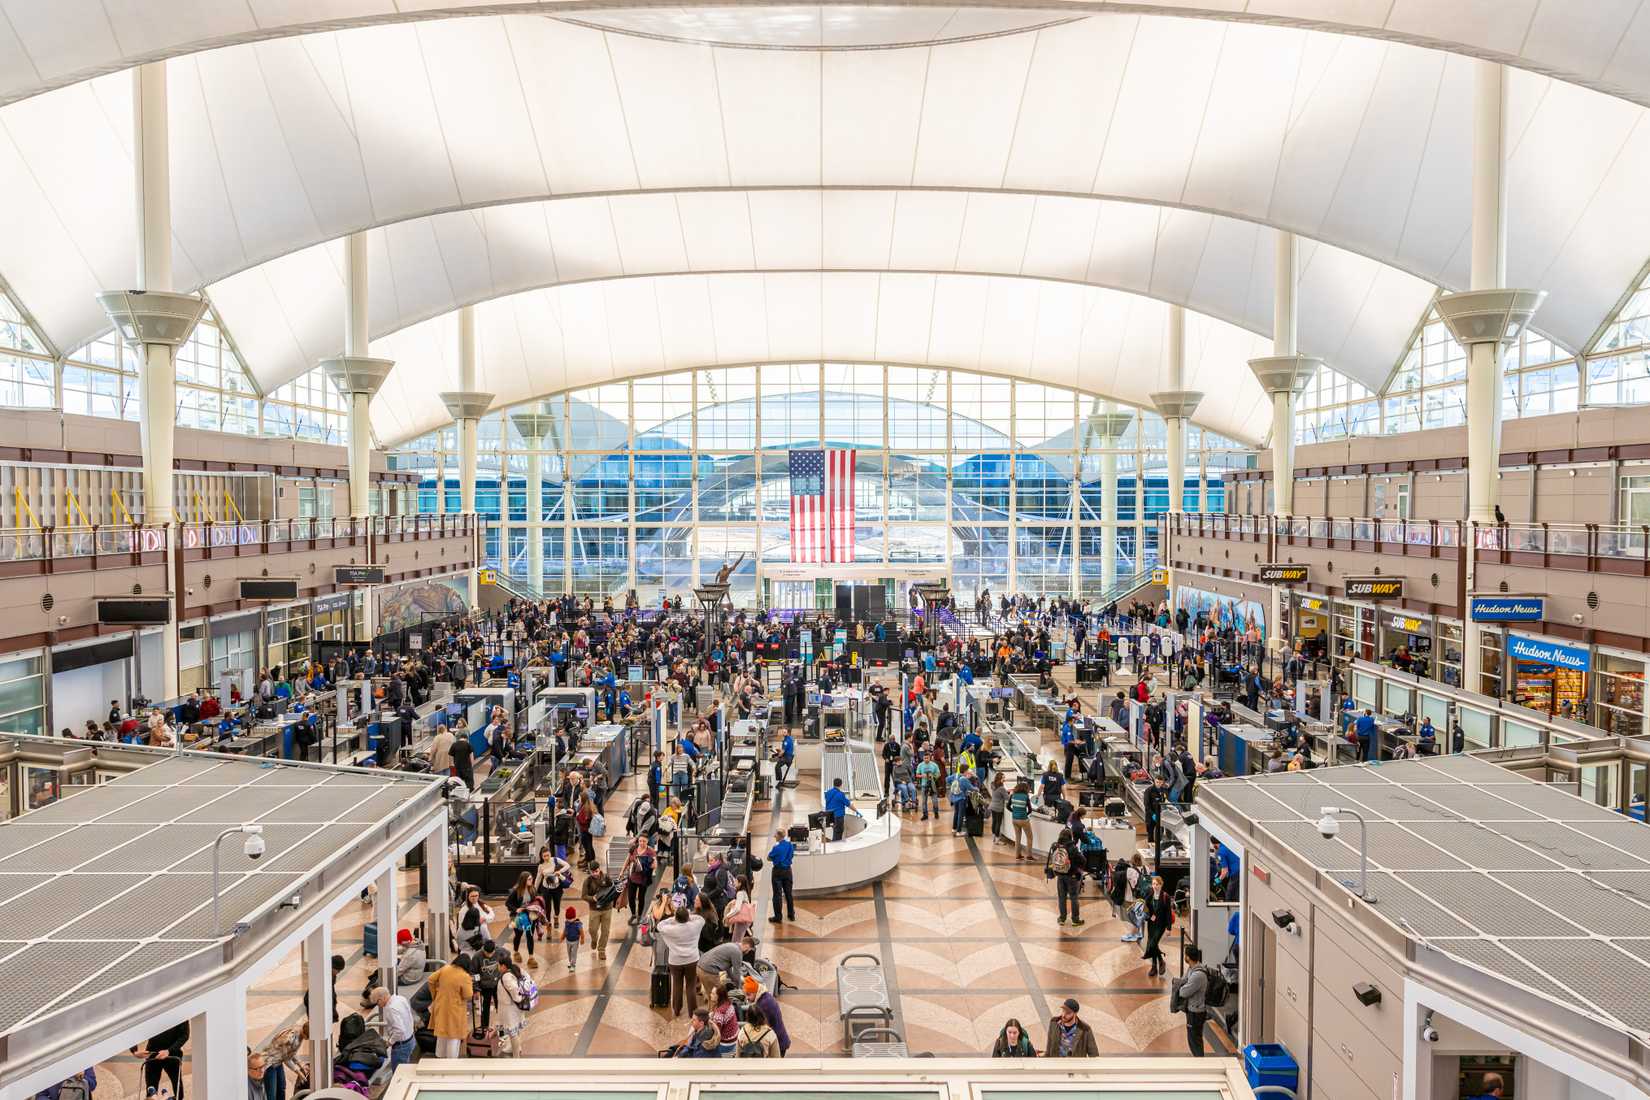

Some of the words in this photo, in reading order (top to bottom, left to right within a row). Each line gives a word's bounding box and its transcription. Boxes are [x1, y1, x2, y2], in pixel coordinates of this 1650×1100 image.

[1263, 570, 1305, 579] SUBWAY
[1348, 583, 1400, 594] SUBWAY
[1301, 598, 1322, 609] SUBWAY
[1474, 604, 1511, 613] Hudson
[1511, 604, 1541, 614] News
[1391, 616, 1422, 631] SUBWAY
[1513, 641, 1551, 660] Hudson
[1552, 649, 1585, 666] News
